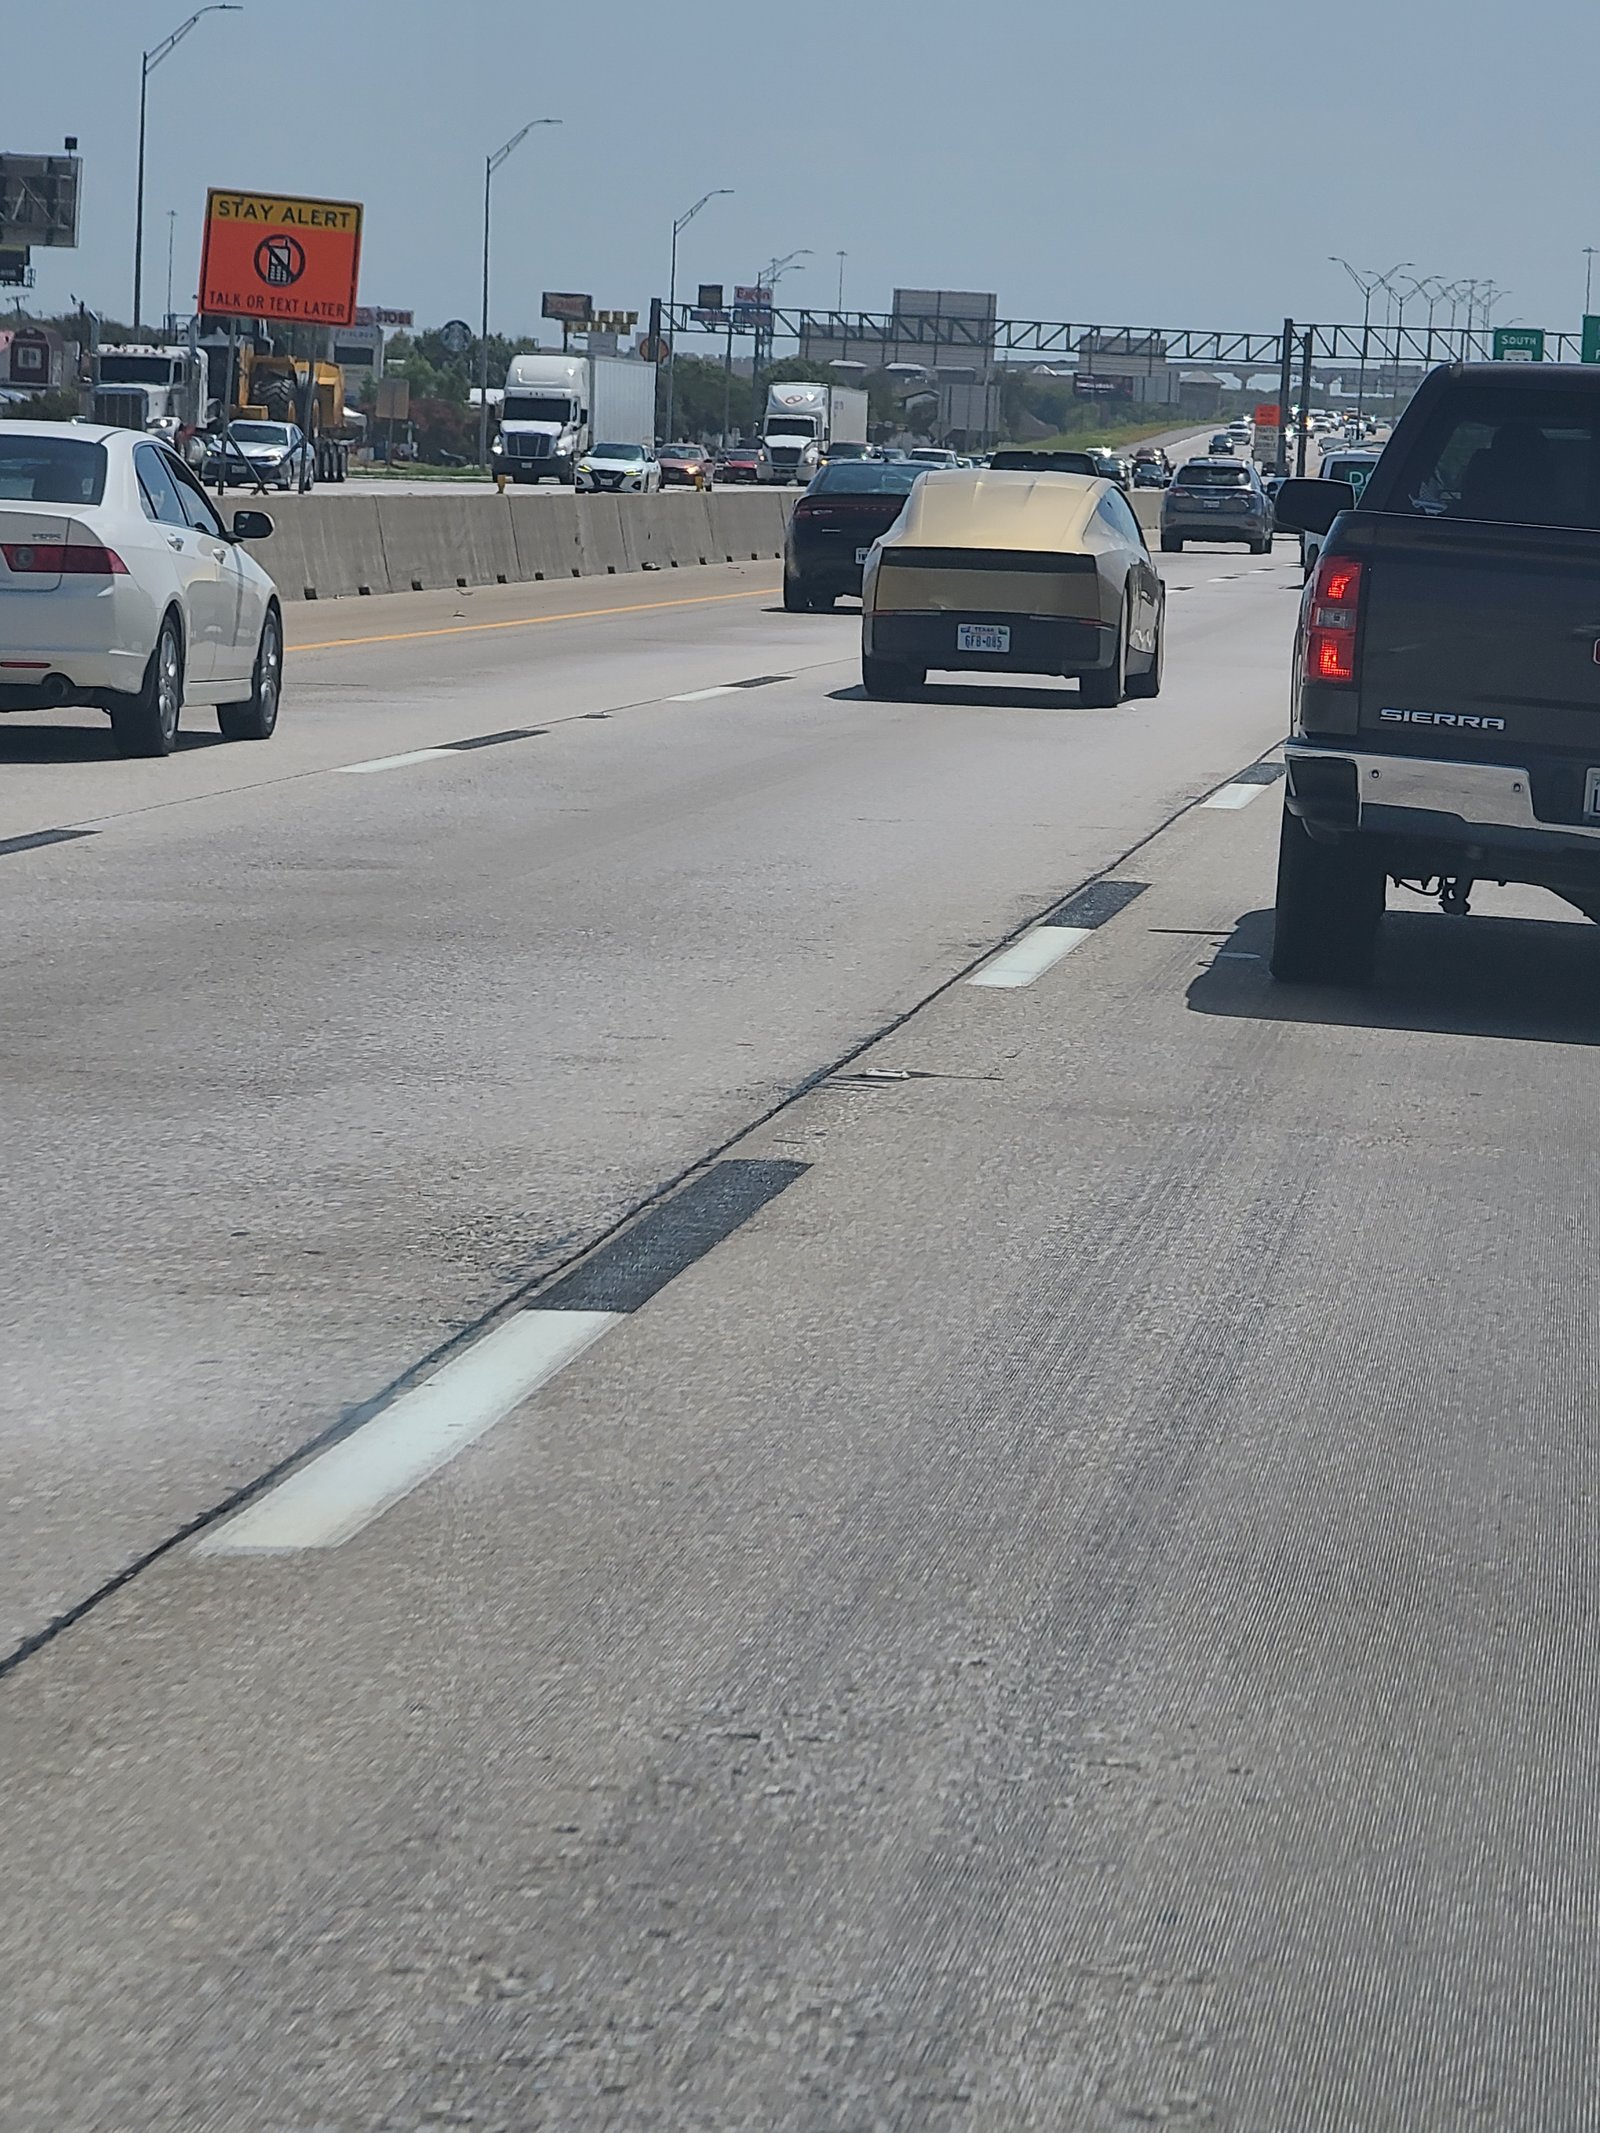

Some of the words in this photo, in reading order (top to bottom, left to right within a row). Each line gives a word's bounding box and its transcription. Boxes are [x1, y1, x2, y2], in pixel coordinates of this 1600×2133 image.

[218, 200, 274, 221] STAY
[280, 206, 350, 228] ALERT
[209, 291, 240, 307] TALK
[246, 295, 264, 309] OR
[269, 297, 300, 314] TEXT
[303, 301, 345, 318] LATER
[736, 287, 770, 303] Exxn
[1501, 334, 1537, 346] SOUTH
[1379, 708, 1505, 731] SIERRA
